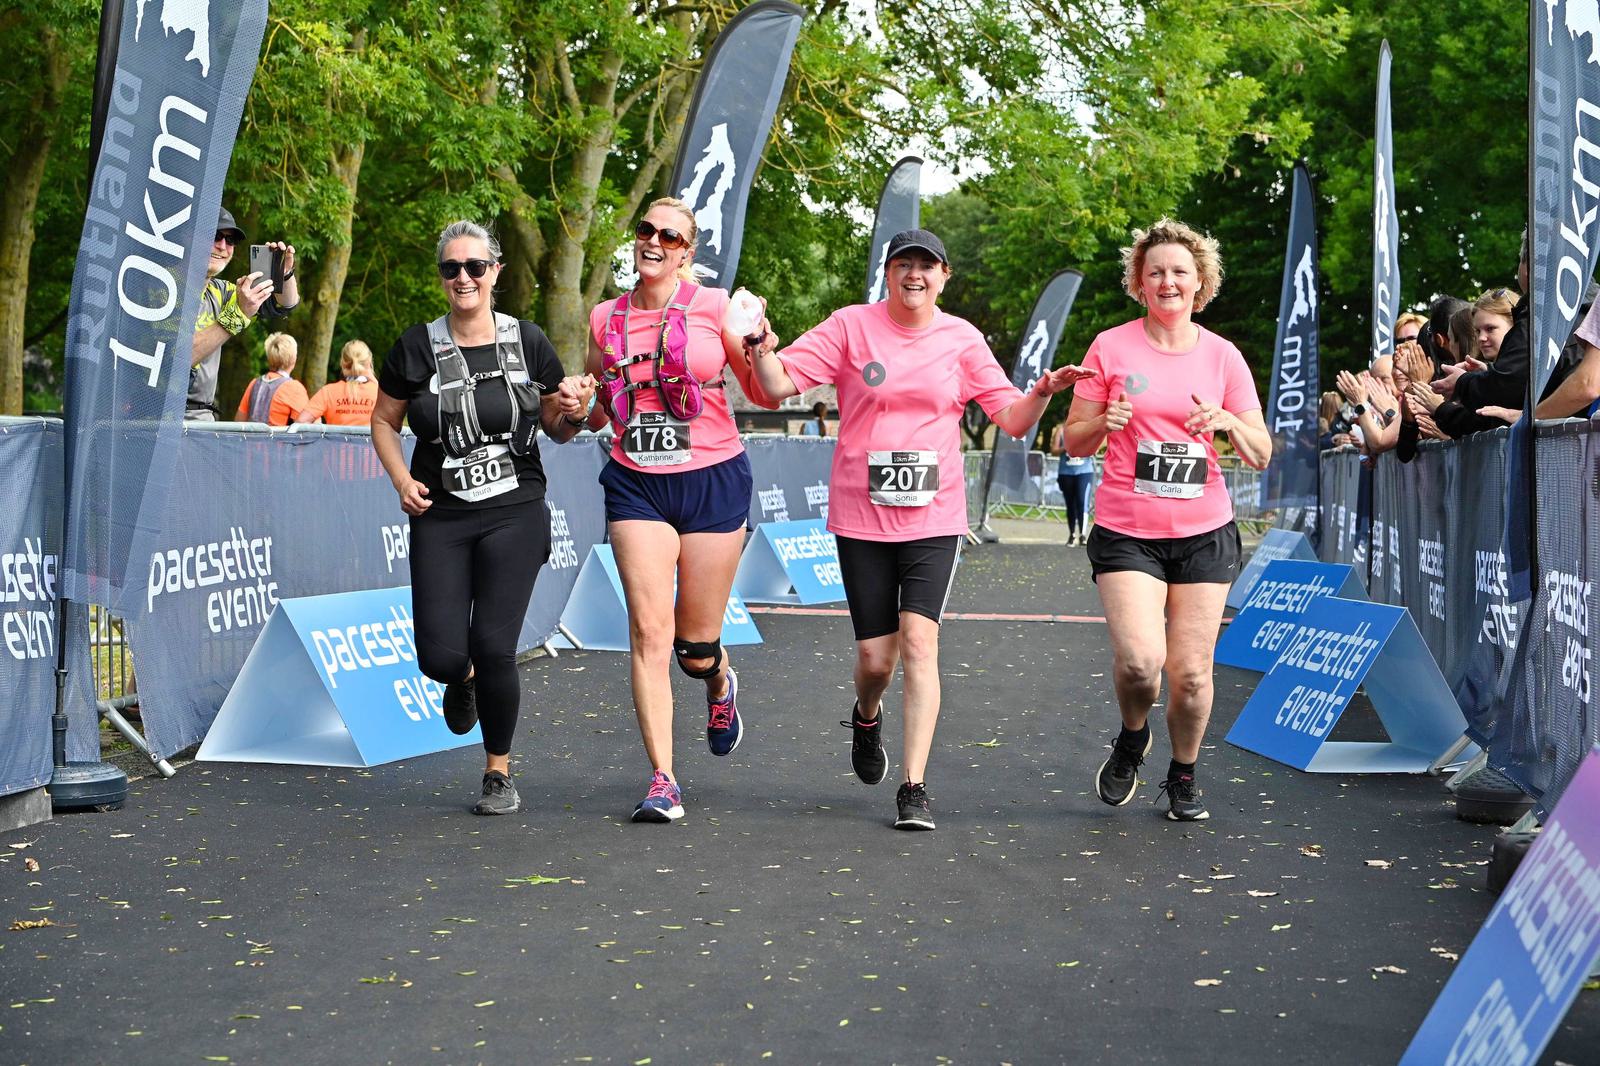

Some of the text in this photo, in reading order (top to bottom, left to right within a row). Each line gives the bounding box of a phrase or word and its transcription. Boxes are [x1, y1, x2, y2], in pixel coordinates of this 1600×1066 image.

[71, 65, 143, 364] Rutland
[109, 95, 208, 388] 10km
[631, 426, 677, 451] 178
[638, 454, 674, 462] Katharine
[1149, 457, 1197, 483] 177
[454, 460, 502, 490] 180
[880, 467, 929, 491] 207
[1160, 484, 1182, 494] Carla
[895, 493, 918, 502] Sonia
[147, 526, 272, 613] pacesetter
[1268, 621, 1379, 680] pacesetter
[1275, 679, 1346, 737] events
